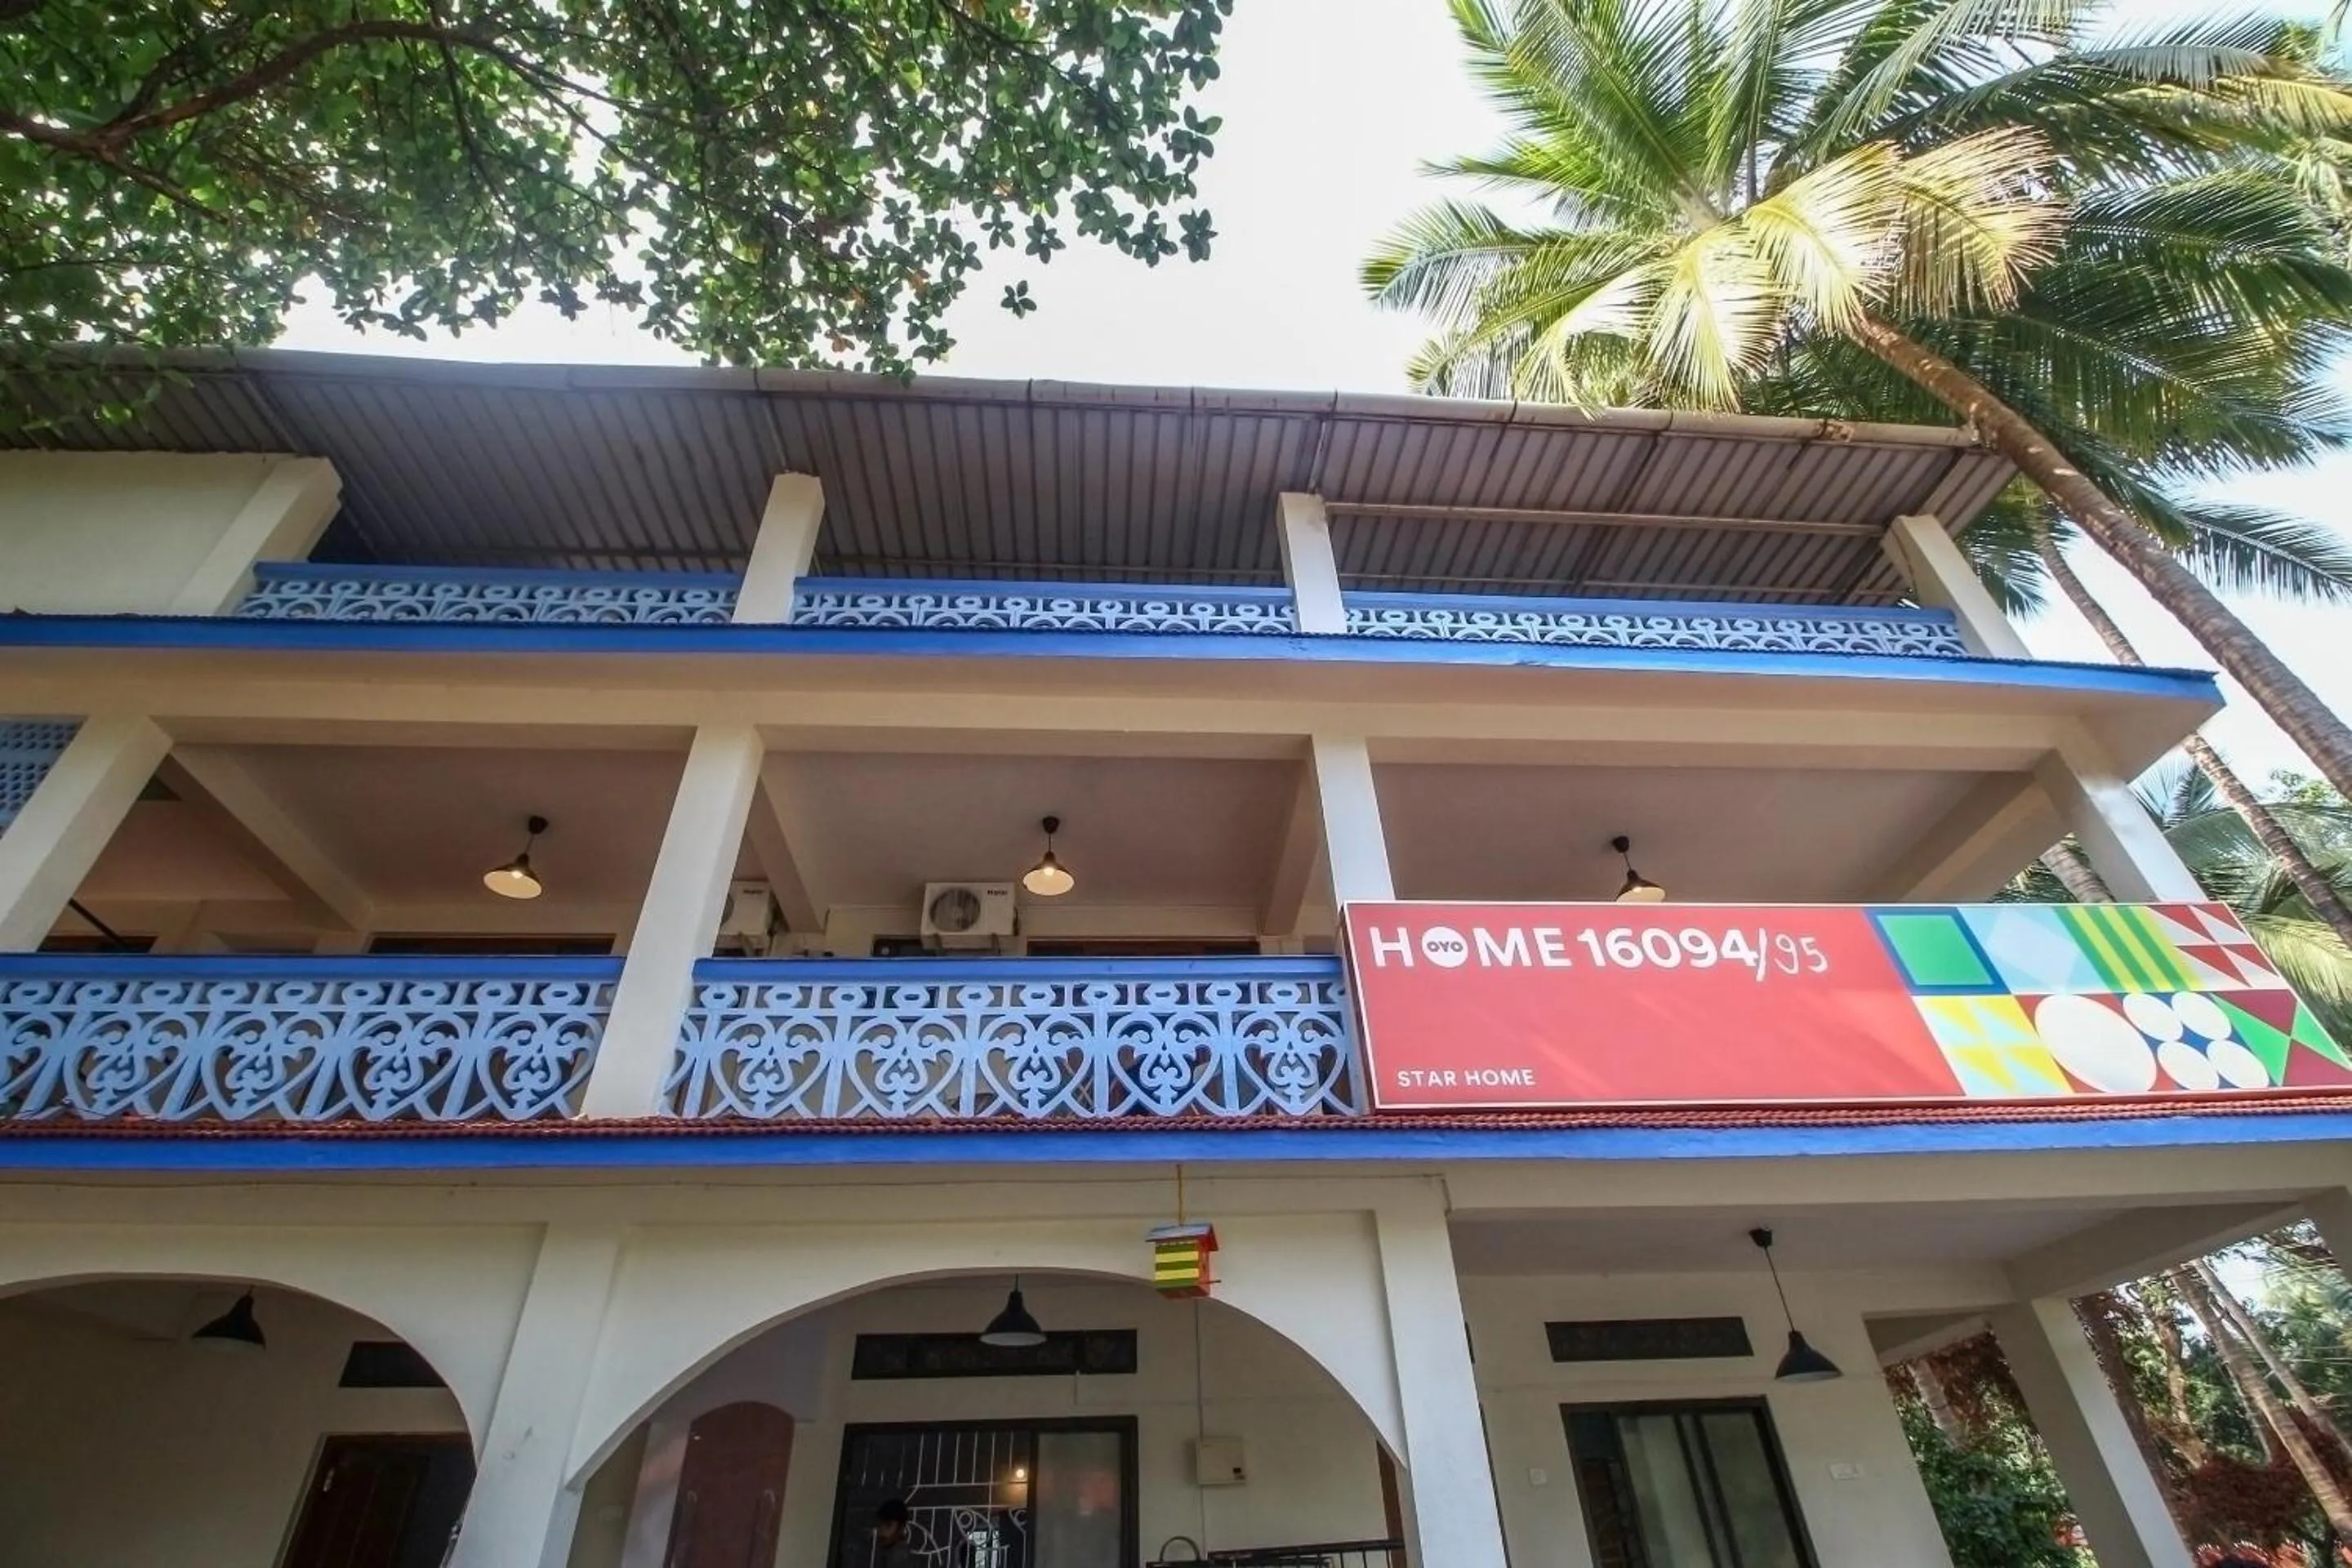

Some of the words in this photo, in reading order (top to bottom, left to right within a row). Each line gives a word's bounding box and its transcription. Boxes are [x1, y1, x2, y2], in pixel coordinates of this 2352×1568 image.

[1426, 940, 1464, 953] OYO
[1397, 1070, 1457, 1088] STAR
[1464, 1068, 1536, 1086] HOME
